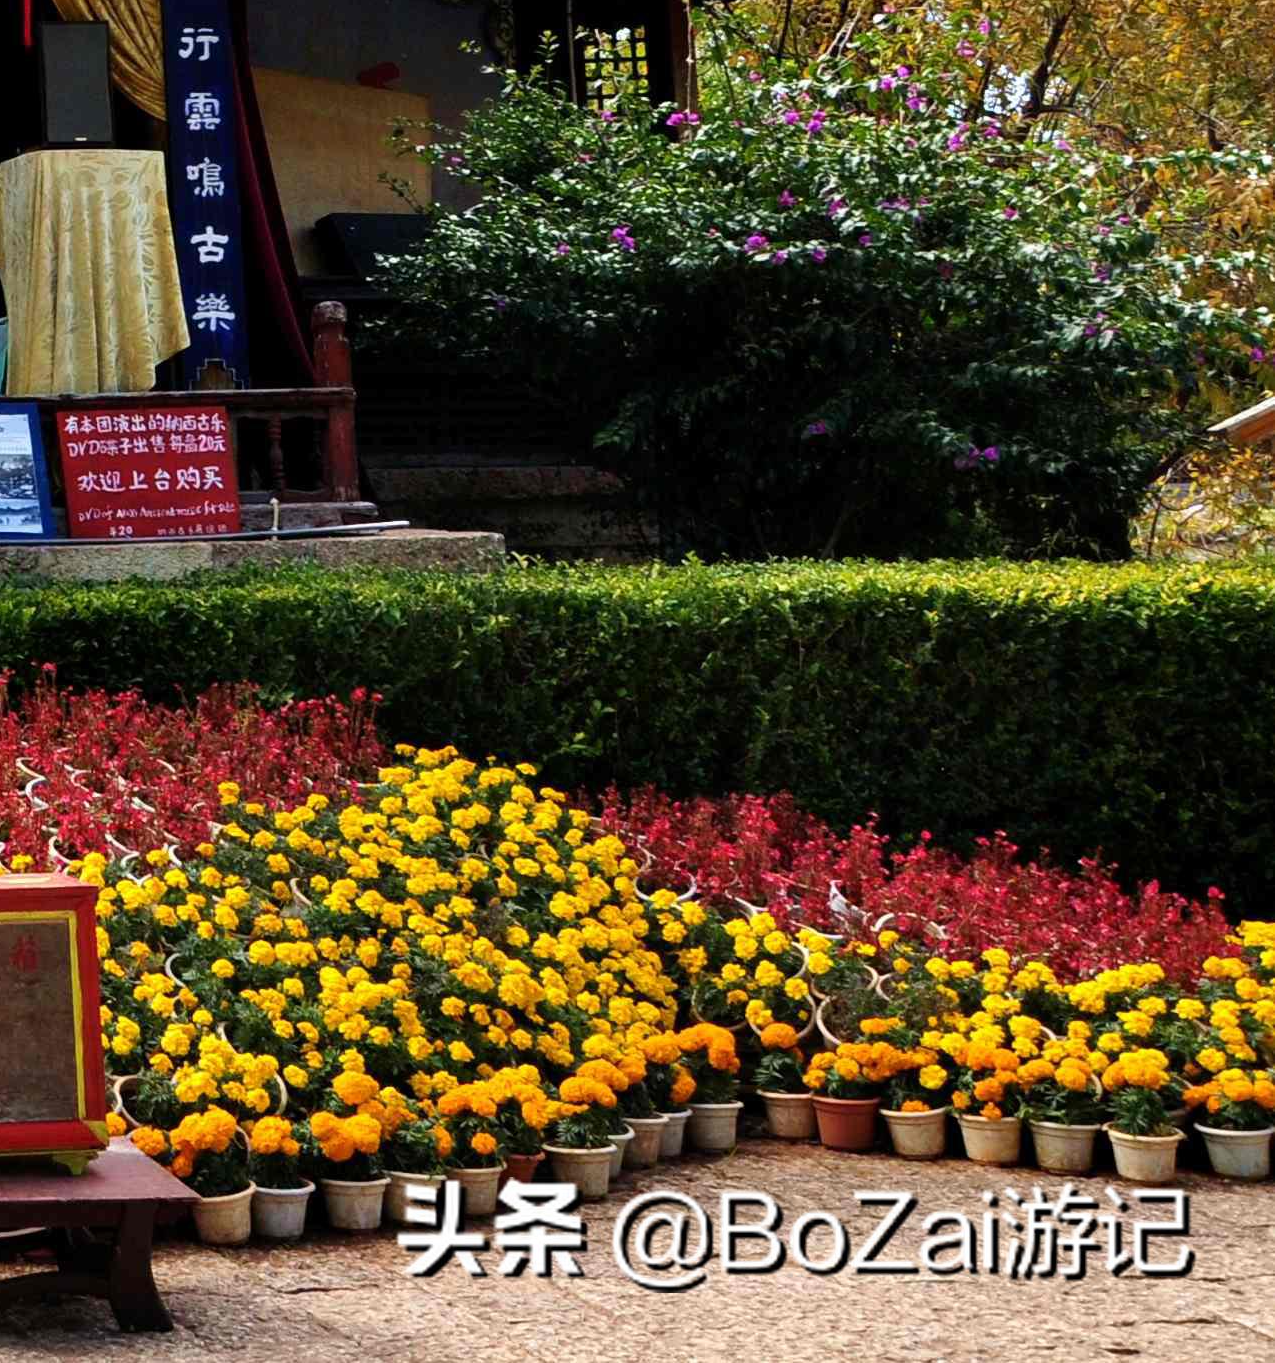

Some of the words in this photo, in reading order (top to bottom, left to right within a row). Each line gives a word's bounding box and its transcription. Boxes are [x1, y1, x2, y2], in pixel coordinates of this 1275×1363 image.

[77, 465, 225, 493] 欢迎上台购买
